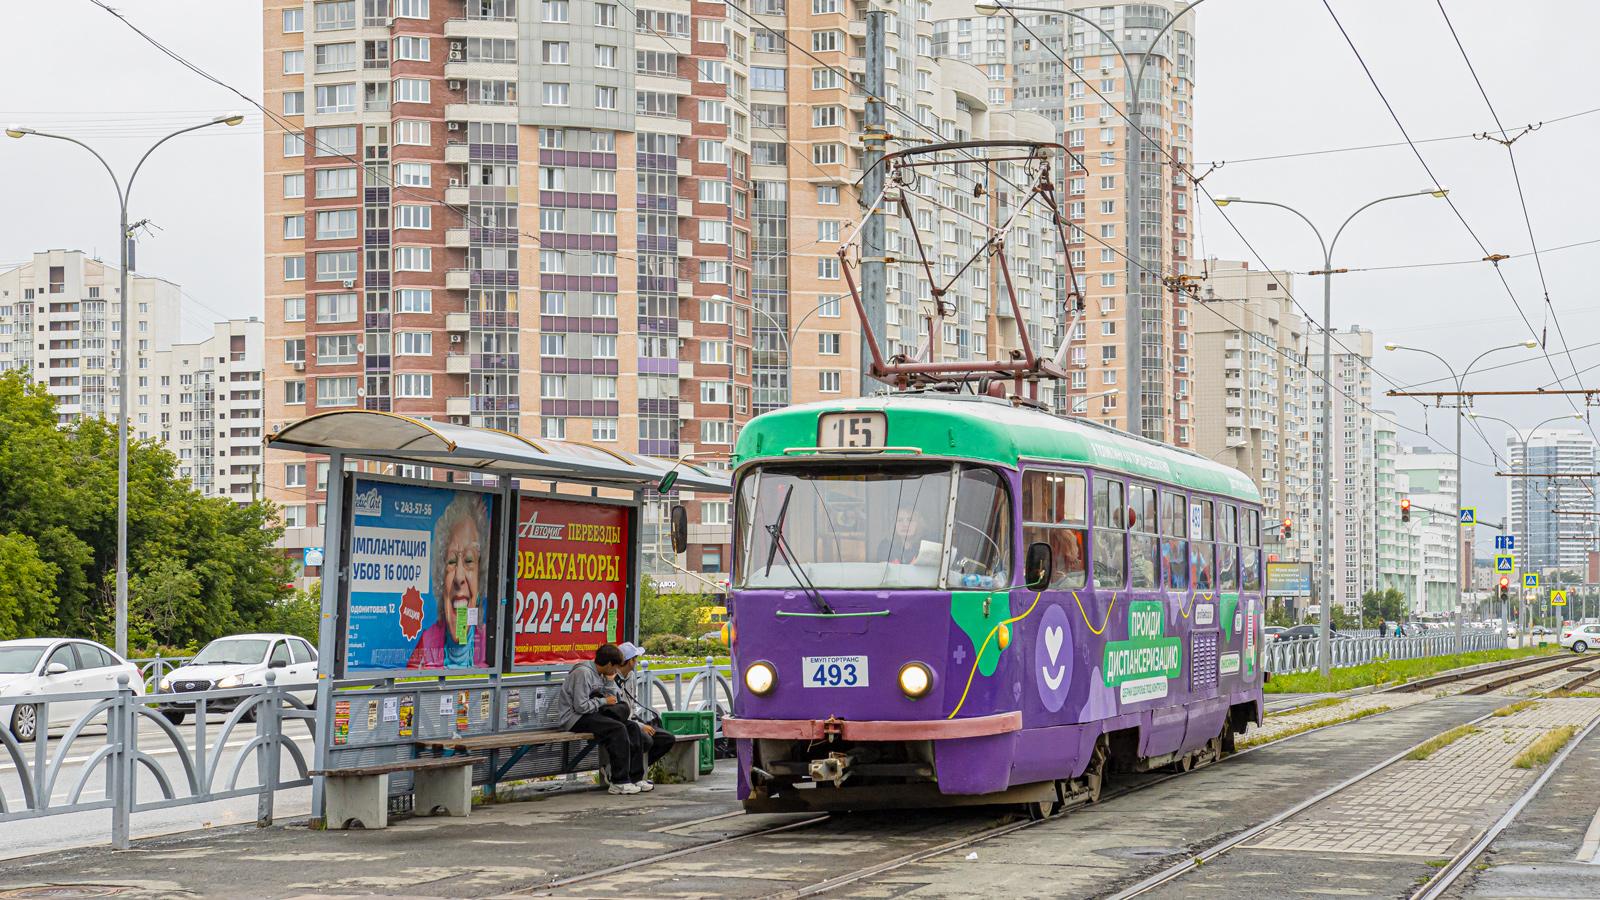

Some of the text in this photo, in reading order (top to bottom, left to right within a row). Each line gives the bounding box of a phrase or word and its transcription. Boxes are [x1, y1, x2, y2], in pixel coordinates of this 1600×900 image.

[833, 417, 871, 447] 15
[400, 501, 432, 515] 243-57-56
[1192, 507, 1200, 527] 493
[567, 523, 620, 545] ПЕРЕЕЗДЫ
[384, 564, 394, 581] 16
[517, 550, 620, 582] ЭВАКУАТОРЫ
[389, 603, 395, 614] 12
[403, 607, 420, 620] АКЦИЯ
[1131, 605, 1161, 640] ПРОЙДИ
[551, 644, 572, 653] транспорт
[1107, 645, 1178, 682] ДИСПАНСЕРИЗАЦИЮ
[813, 664, 857, 686] 493
